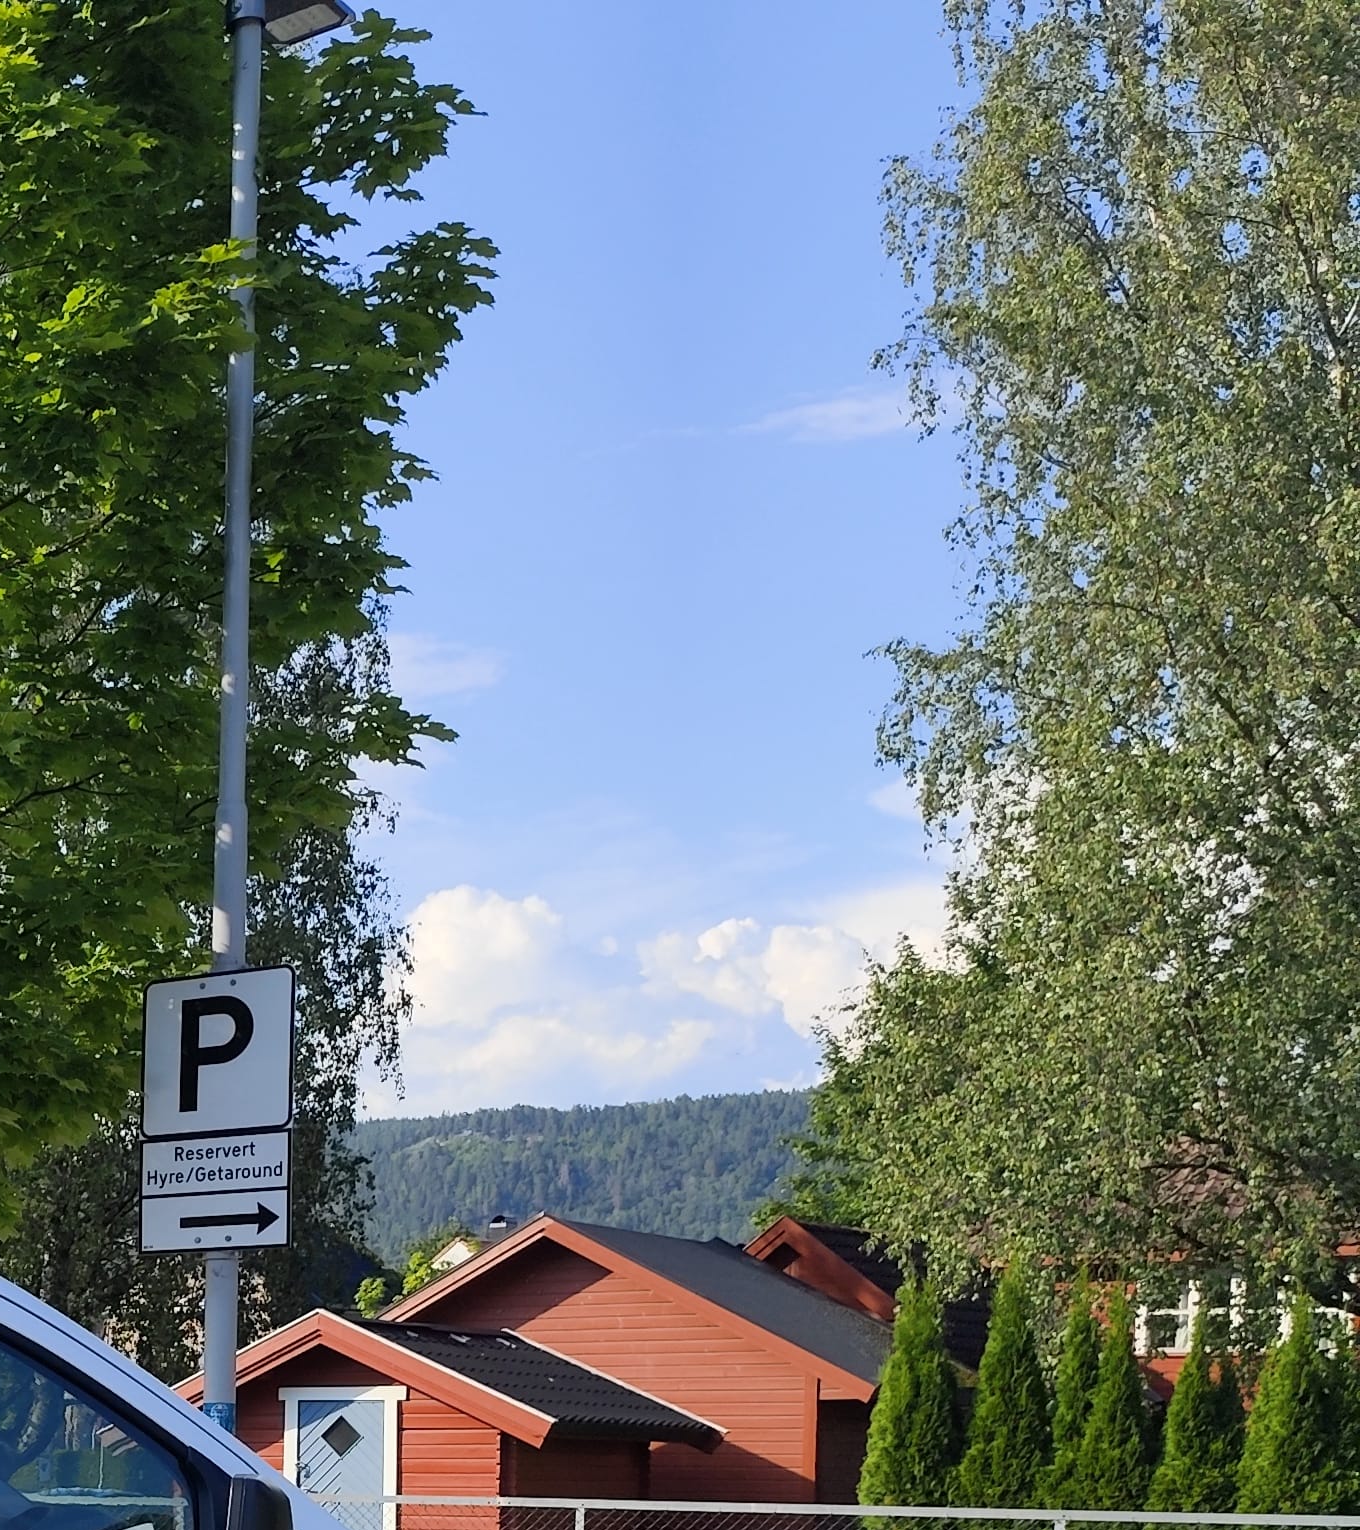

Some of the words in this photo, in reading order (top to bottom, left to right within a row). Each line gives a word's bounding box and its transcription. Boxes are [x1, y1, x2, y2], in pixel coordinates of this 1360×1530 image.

[179, 995, 255, 1113] P
[174, 1141, 256, 1162] Reservert
[146, 1161, 284, 1189] Hyre/Getaround
